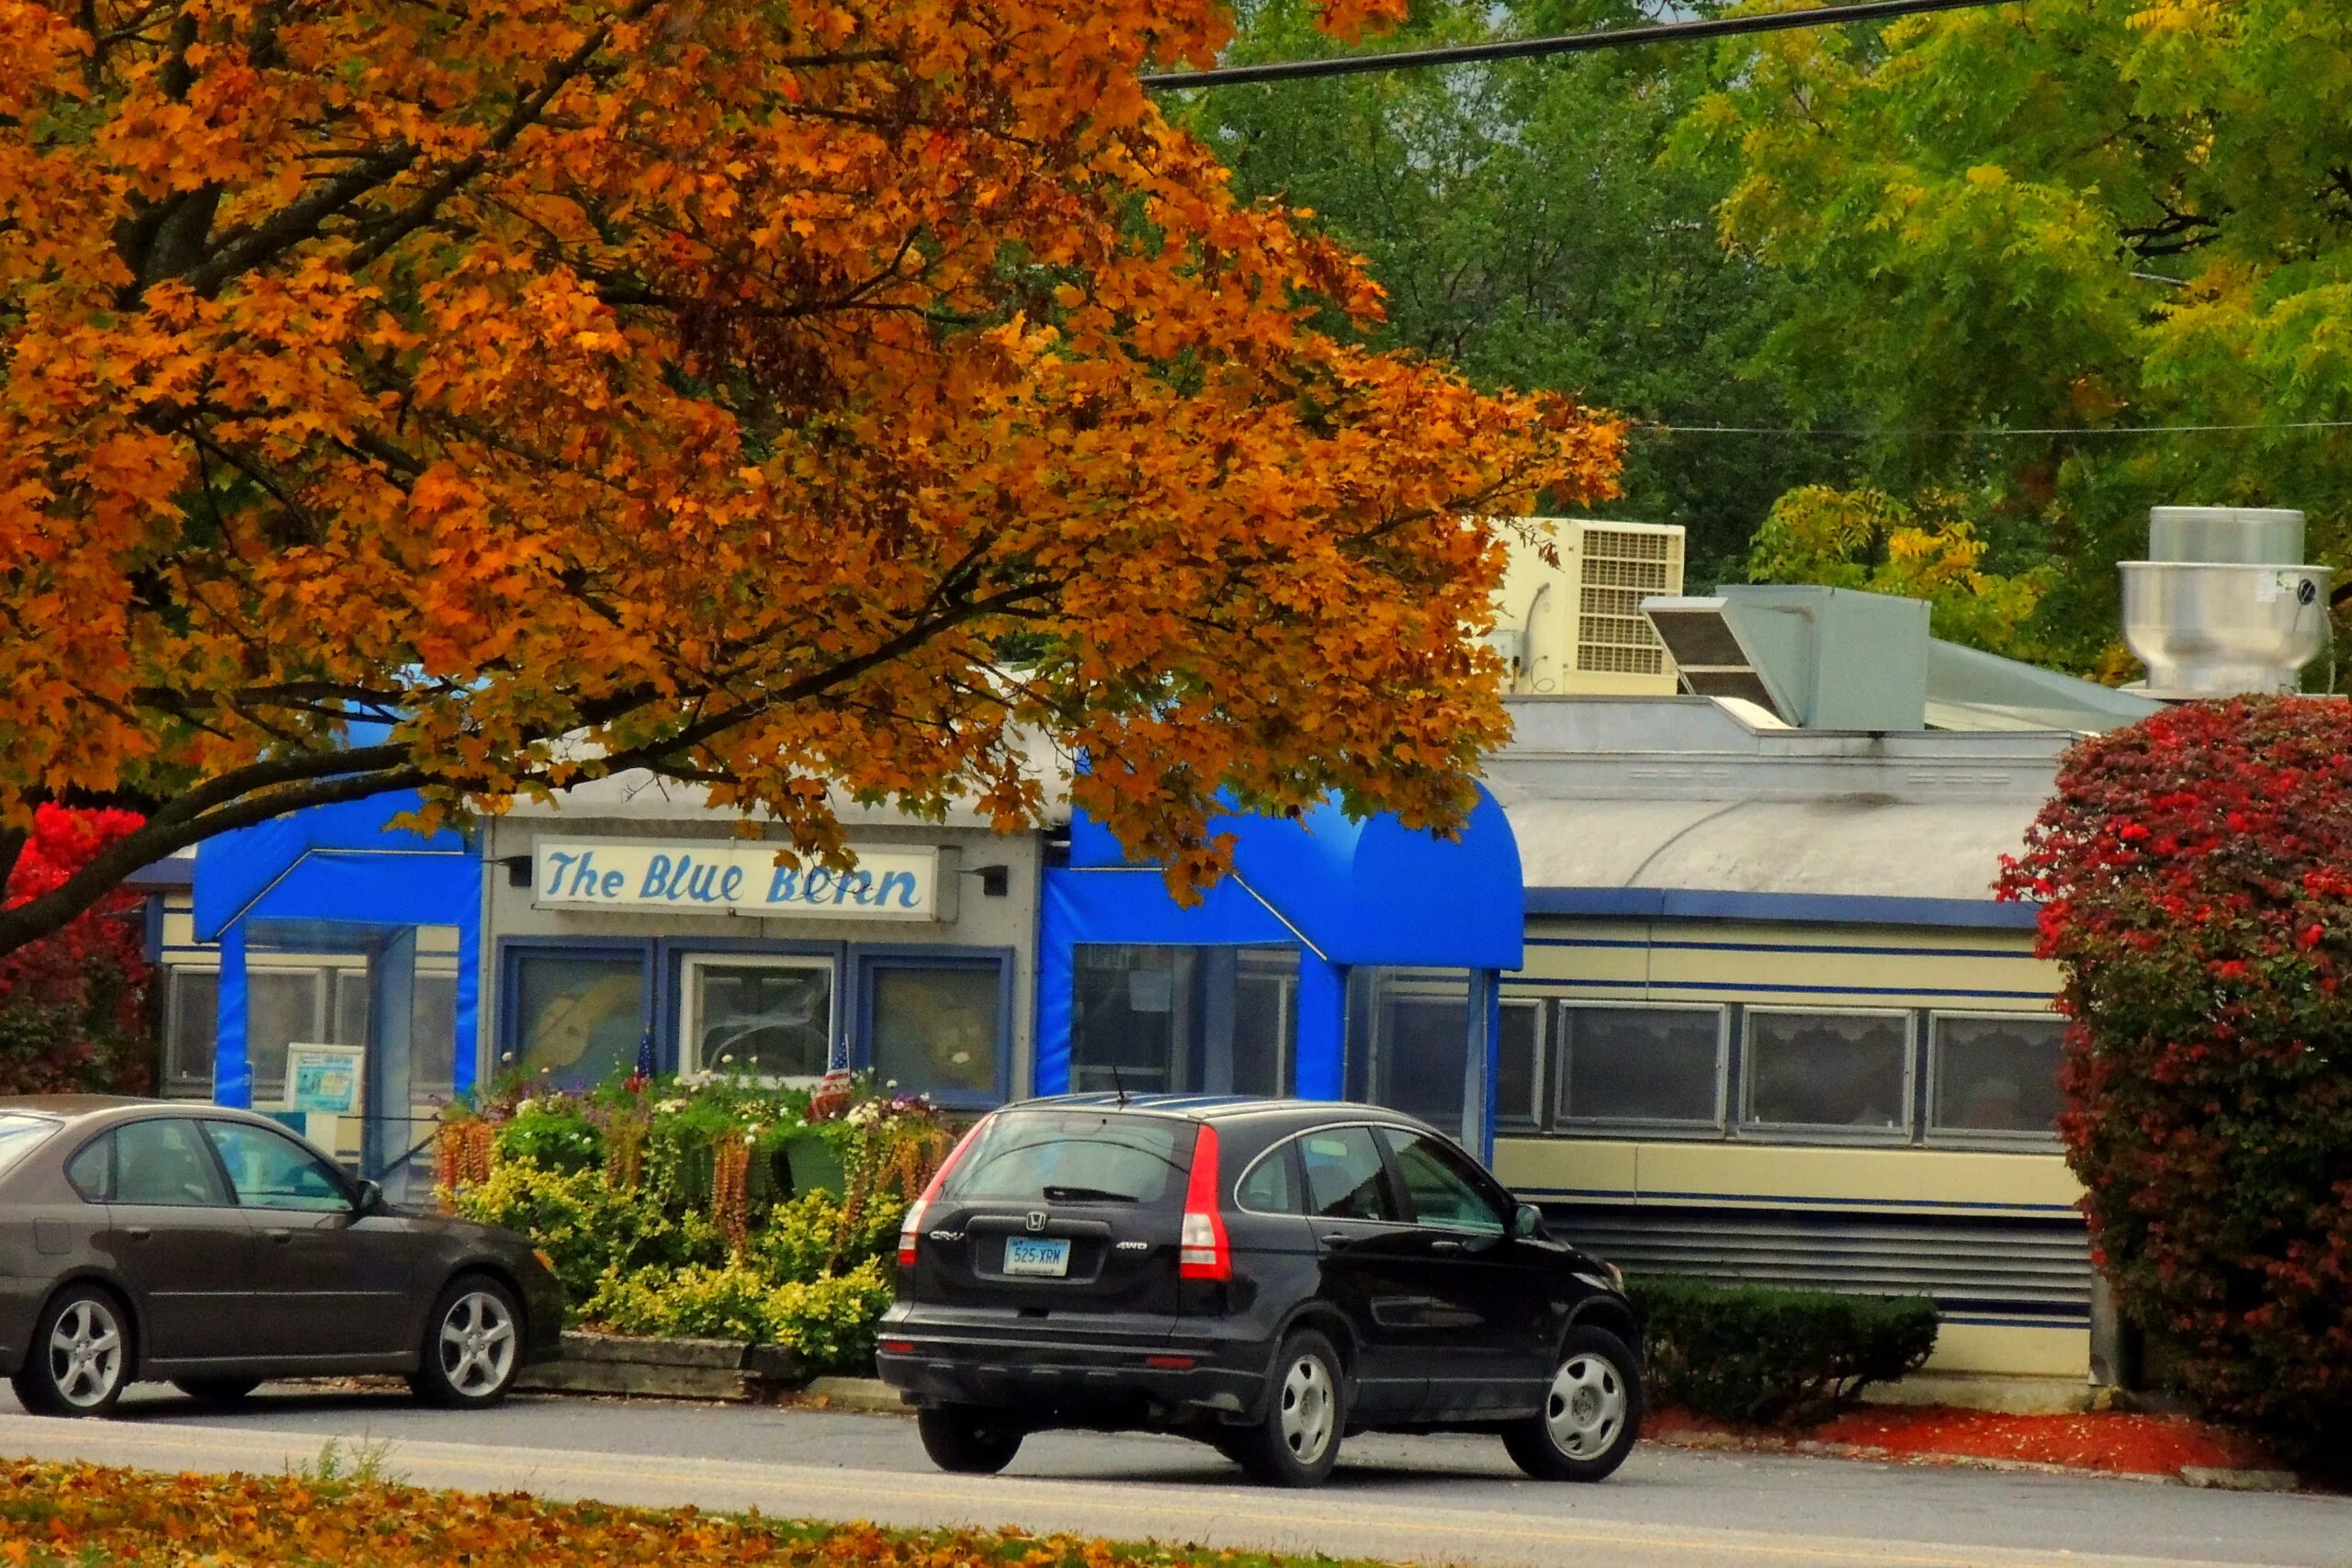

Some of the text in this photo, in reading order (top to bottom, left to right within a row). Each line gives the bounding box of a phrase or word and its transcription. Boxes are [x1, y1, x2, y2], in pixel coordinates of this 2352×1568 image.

[547, 851, 922, 908] The Blue Benn
[1115, 1241, 1148, 1250] 4WD
